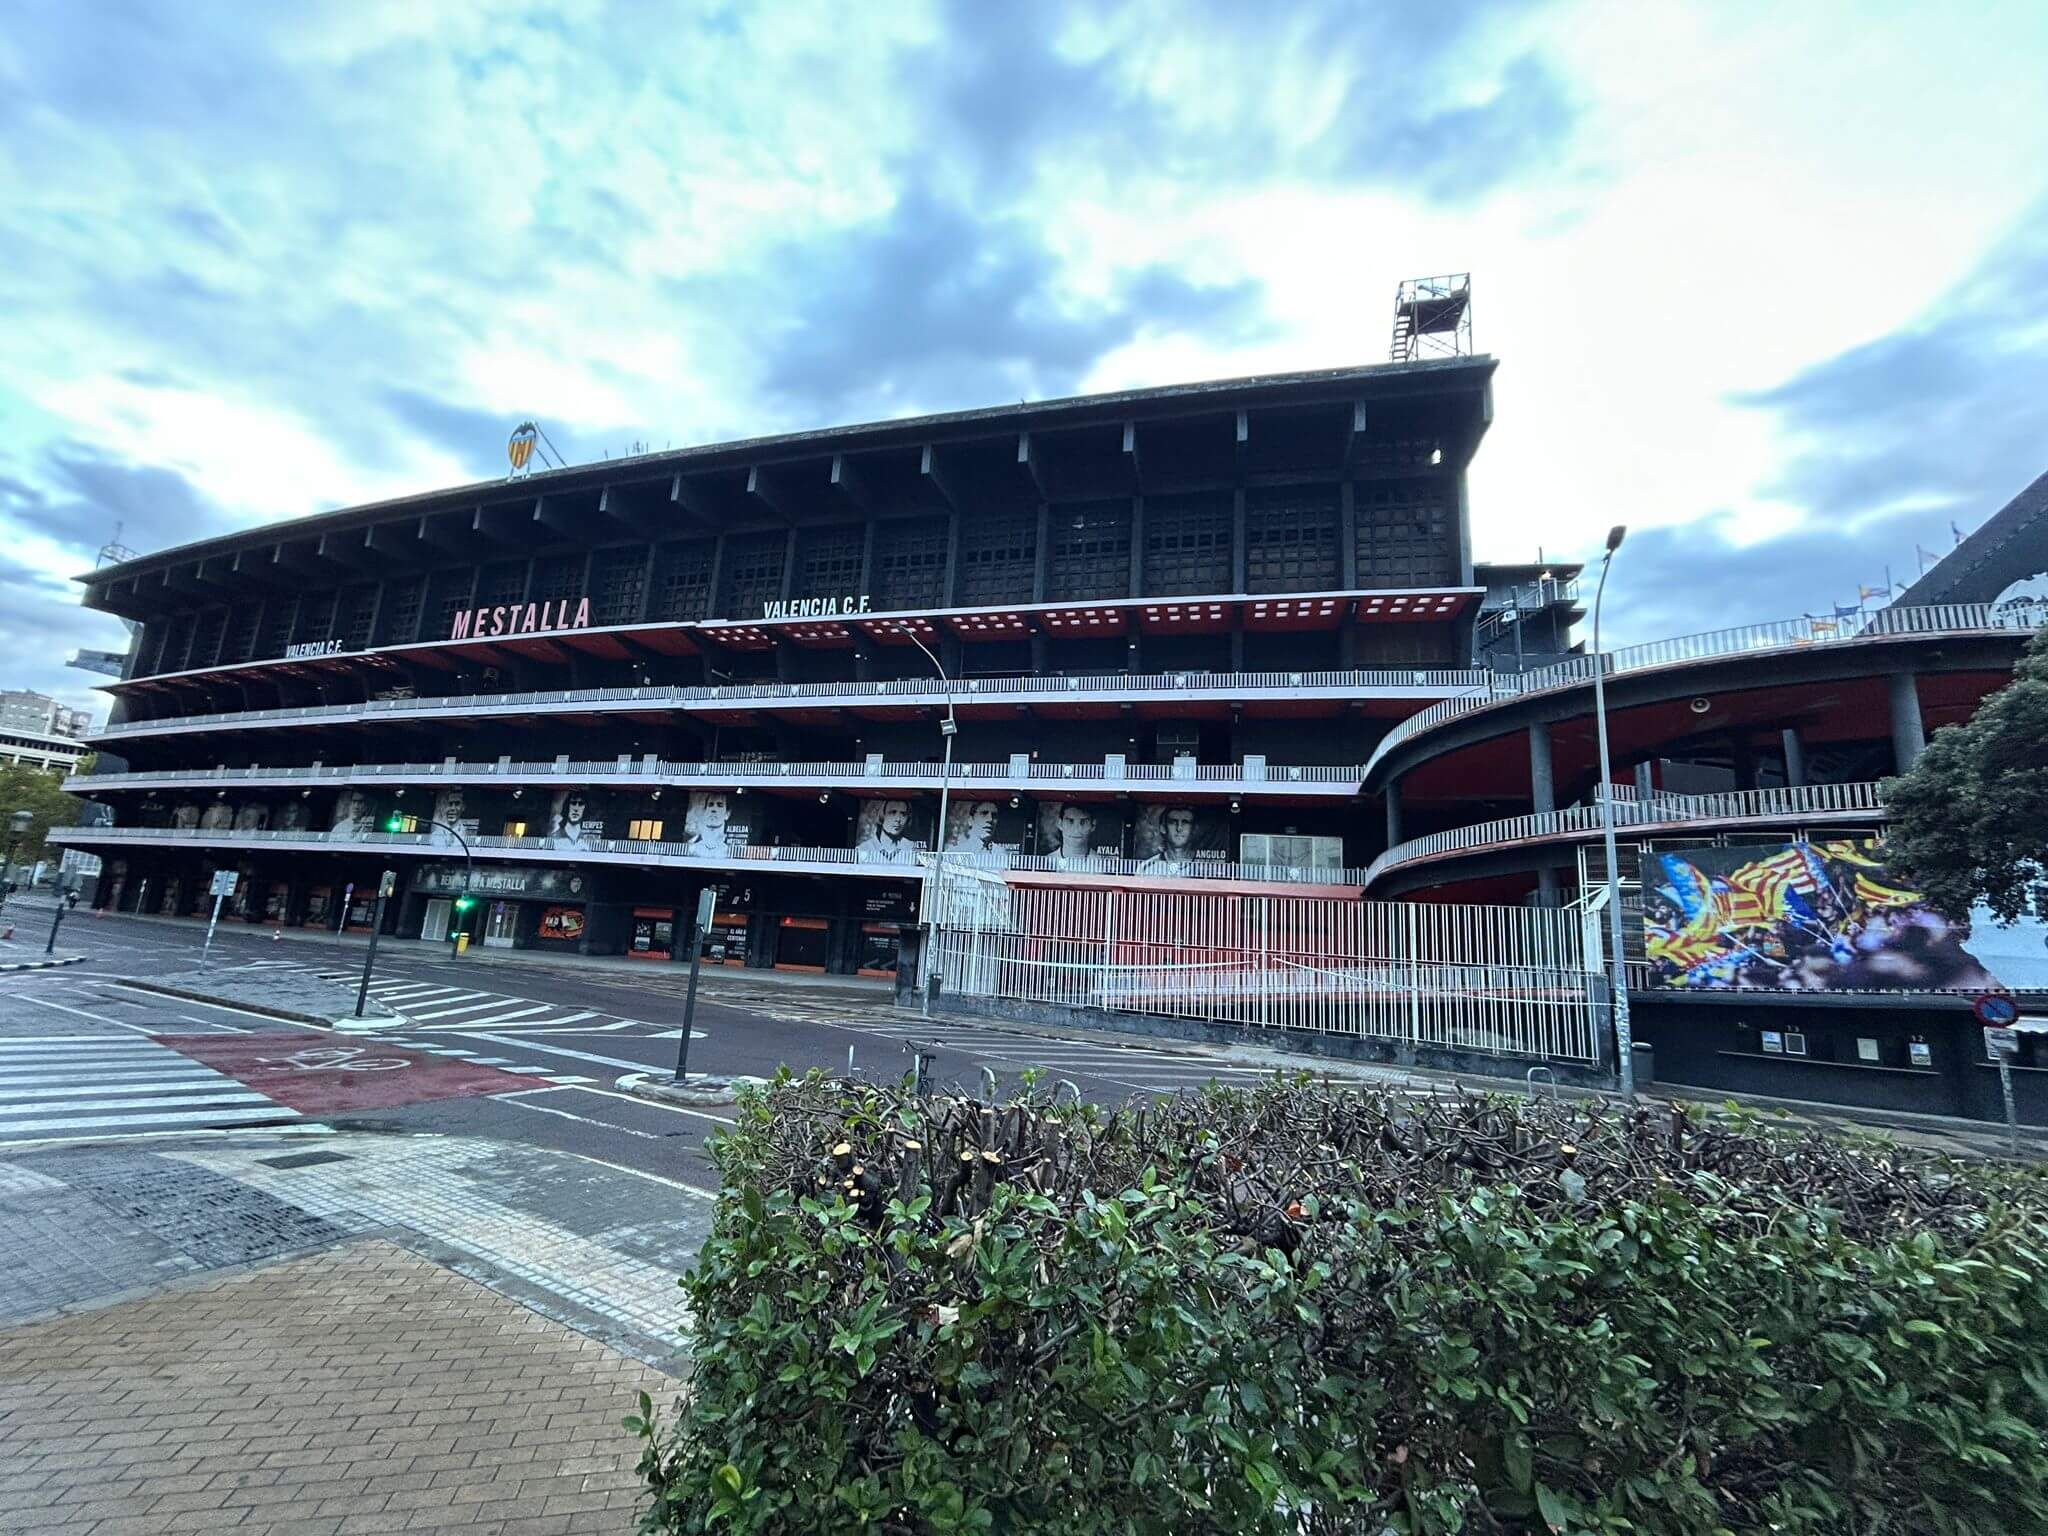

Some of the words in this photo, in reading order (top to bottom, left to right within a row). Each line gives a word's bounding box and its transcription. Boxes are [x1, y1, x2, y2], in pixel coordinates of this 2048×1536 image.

[763, 598, 837, 619] VALENCIA
[843, 595, 872, 615] C.F.
[451, 597, 589, 640] MESTALLA
[286, 641, 325, 658] VALENCIA
[326, 639, 343, 655] C.F.
[1096, 846, 1120, 856] AYALA
[1195, 850, 1227, 860] ANGULO
[486, 877, 526, 891] MESTALLA
[744, 888, 751, 902] 5
